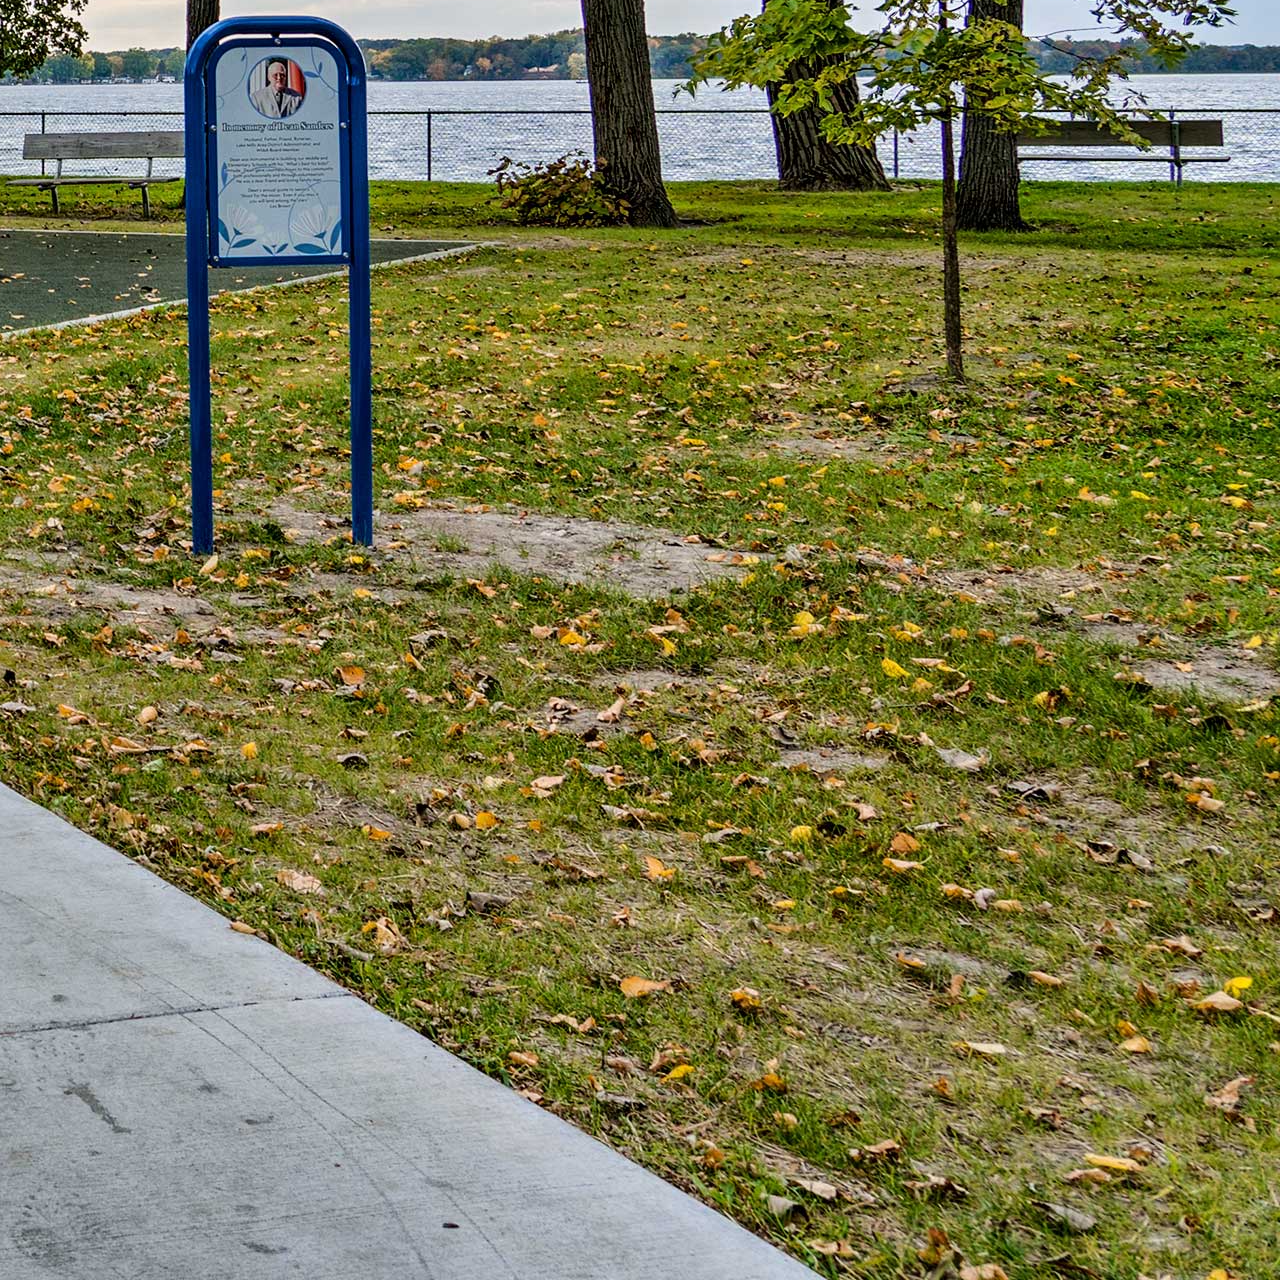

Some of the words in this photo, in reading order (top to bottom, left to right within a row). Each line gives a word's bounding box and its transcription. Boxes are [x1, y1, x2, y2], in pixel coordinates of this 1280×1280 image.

[232, 123, 266, 133] memory
[267, 122, 278, 131] of
[277, 122, 300, 130] Dean
[300, 121, 334, 130] Sanders
